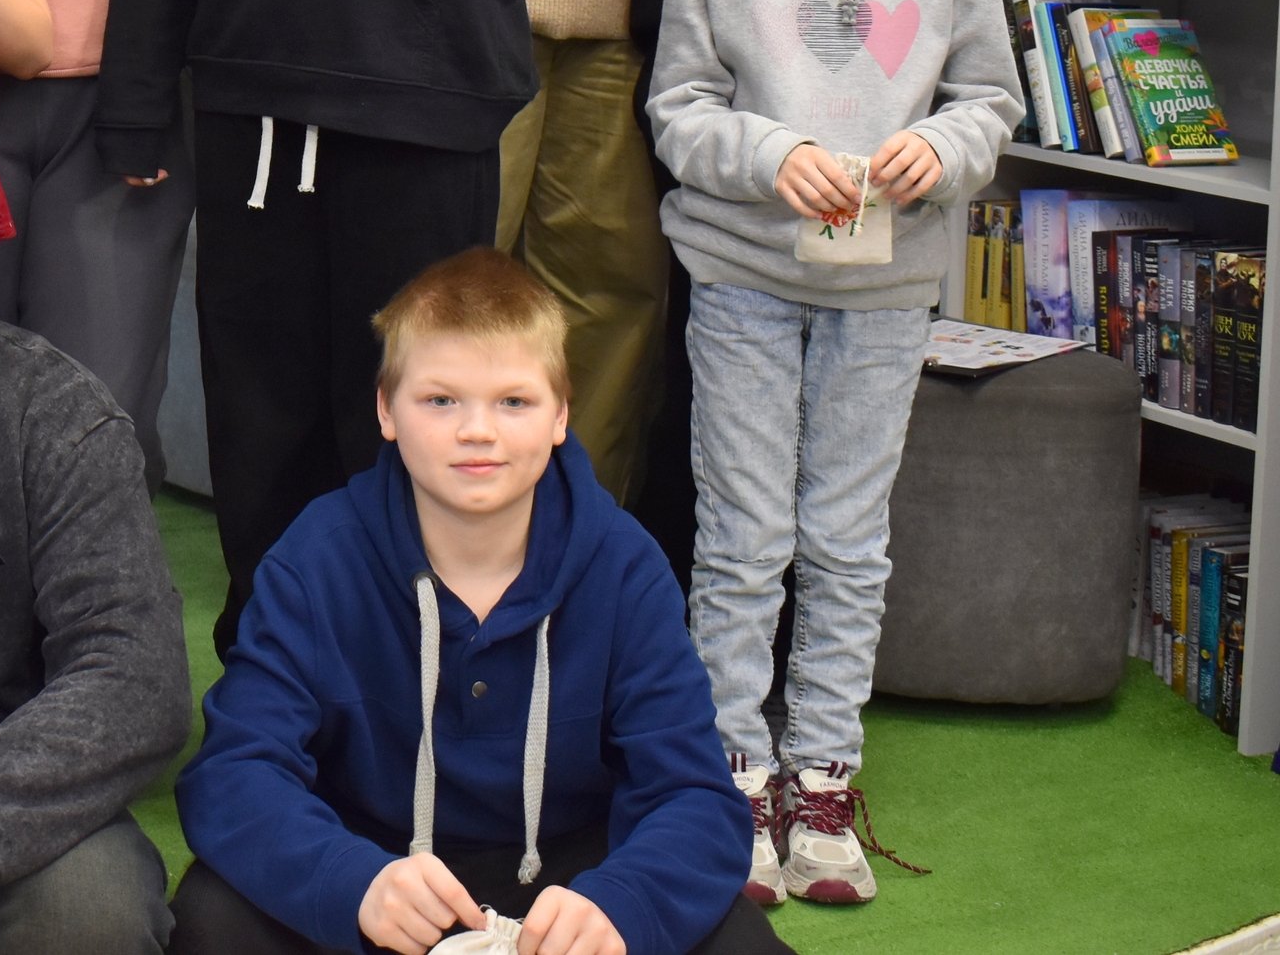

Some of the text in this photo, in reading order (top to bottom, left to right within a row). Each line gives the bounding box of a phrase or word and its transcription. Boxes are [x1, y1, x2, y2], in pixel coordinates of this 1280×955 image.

[1134, 59, 1203, 74] ДЕВОЧКА
[1137, 74, 1208, 90] СЧАСТЬЯ
[1149, 96, 1215, 125] удачи
[1170, 132, 1218, 147] СМЕЙЛ
[1174, 124, 1207, 133] ХОЛЛИ
[1078, 212, 1089, 310] ДИАНА ГЭБЛДОН
[1098, 285, 1107, 313] БОГ
[1166, 278, 1174, 307] ЯЦЕК
[1204, 674, 1212, 698] ХОББ
